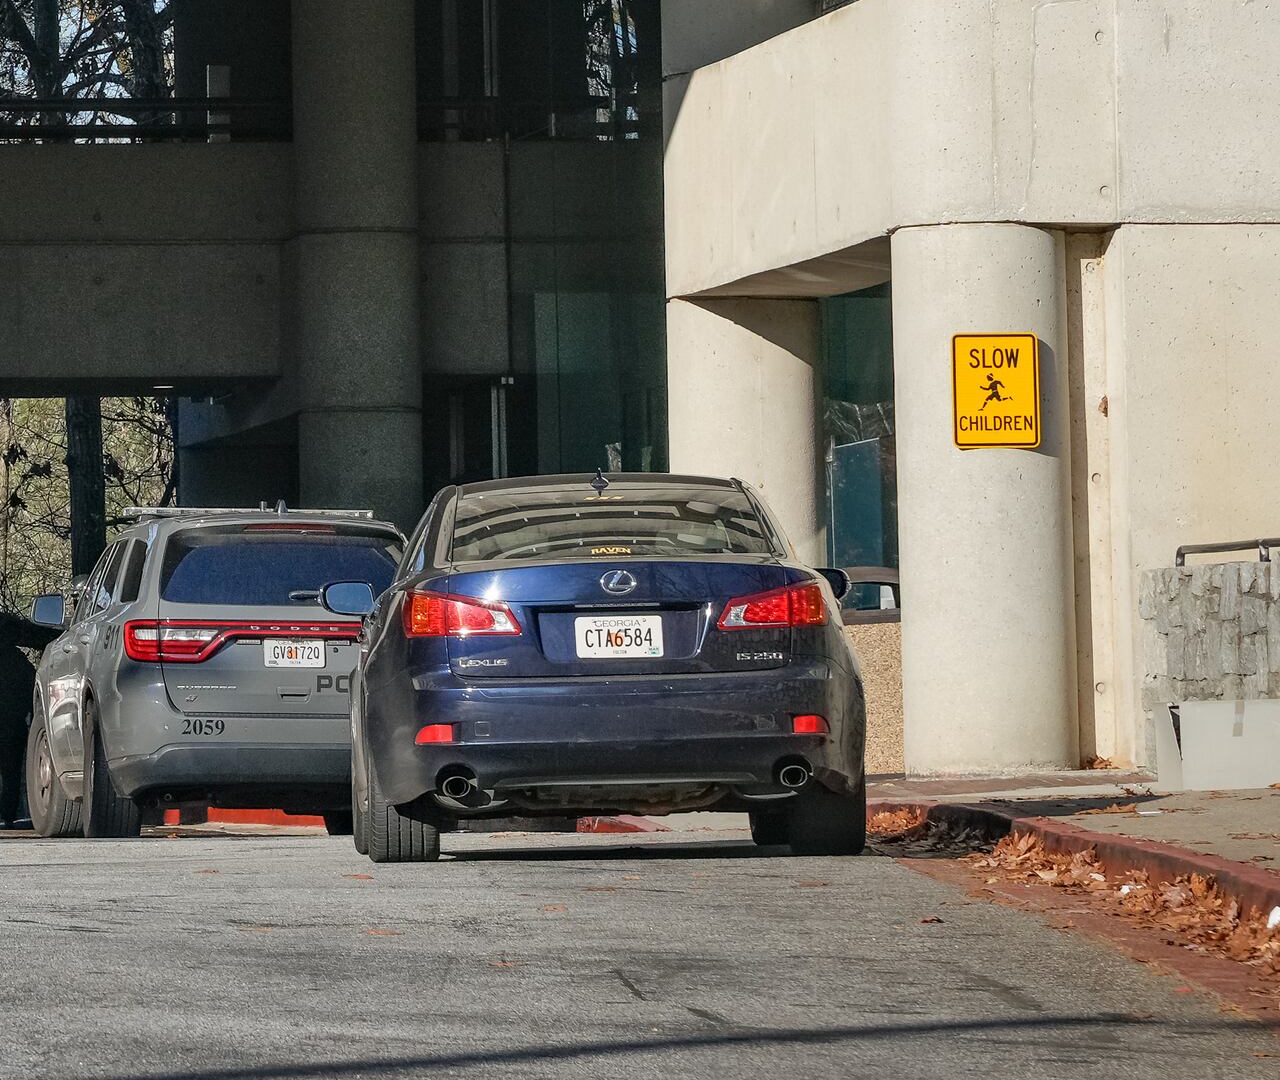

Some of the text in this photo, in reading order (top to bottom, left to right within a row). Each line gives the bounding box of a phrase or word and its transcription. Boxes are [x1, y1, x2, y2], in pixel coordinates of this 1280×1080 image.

[969, 348, 1019, 368] SLOW
[959, 415, 1033, 431] CHILDREN
[595, 619, 640, 627] GEORGIA
[585, 628, 653, 648] CTA6584
[460, 658, 507, 667] LEXUS
[182, 719, 225, 735] 2059
